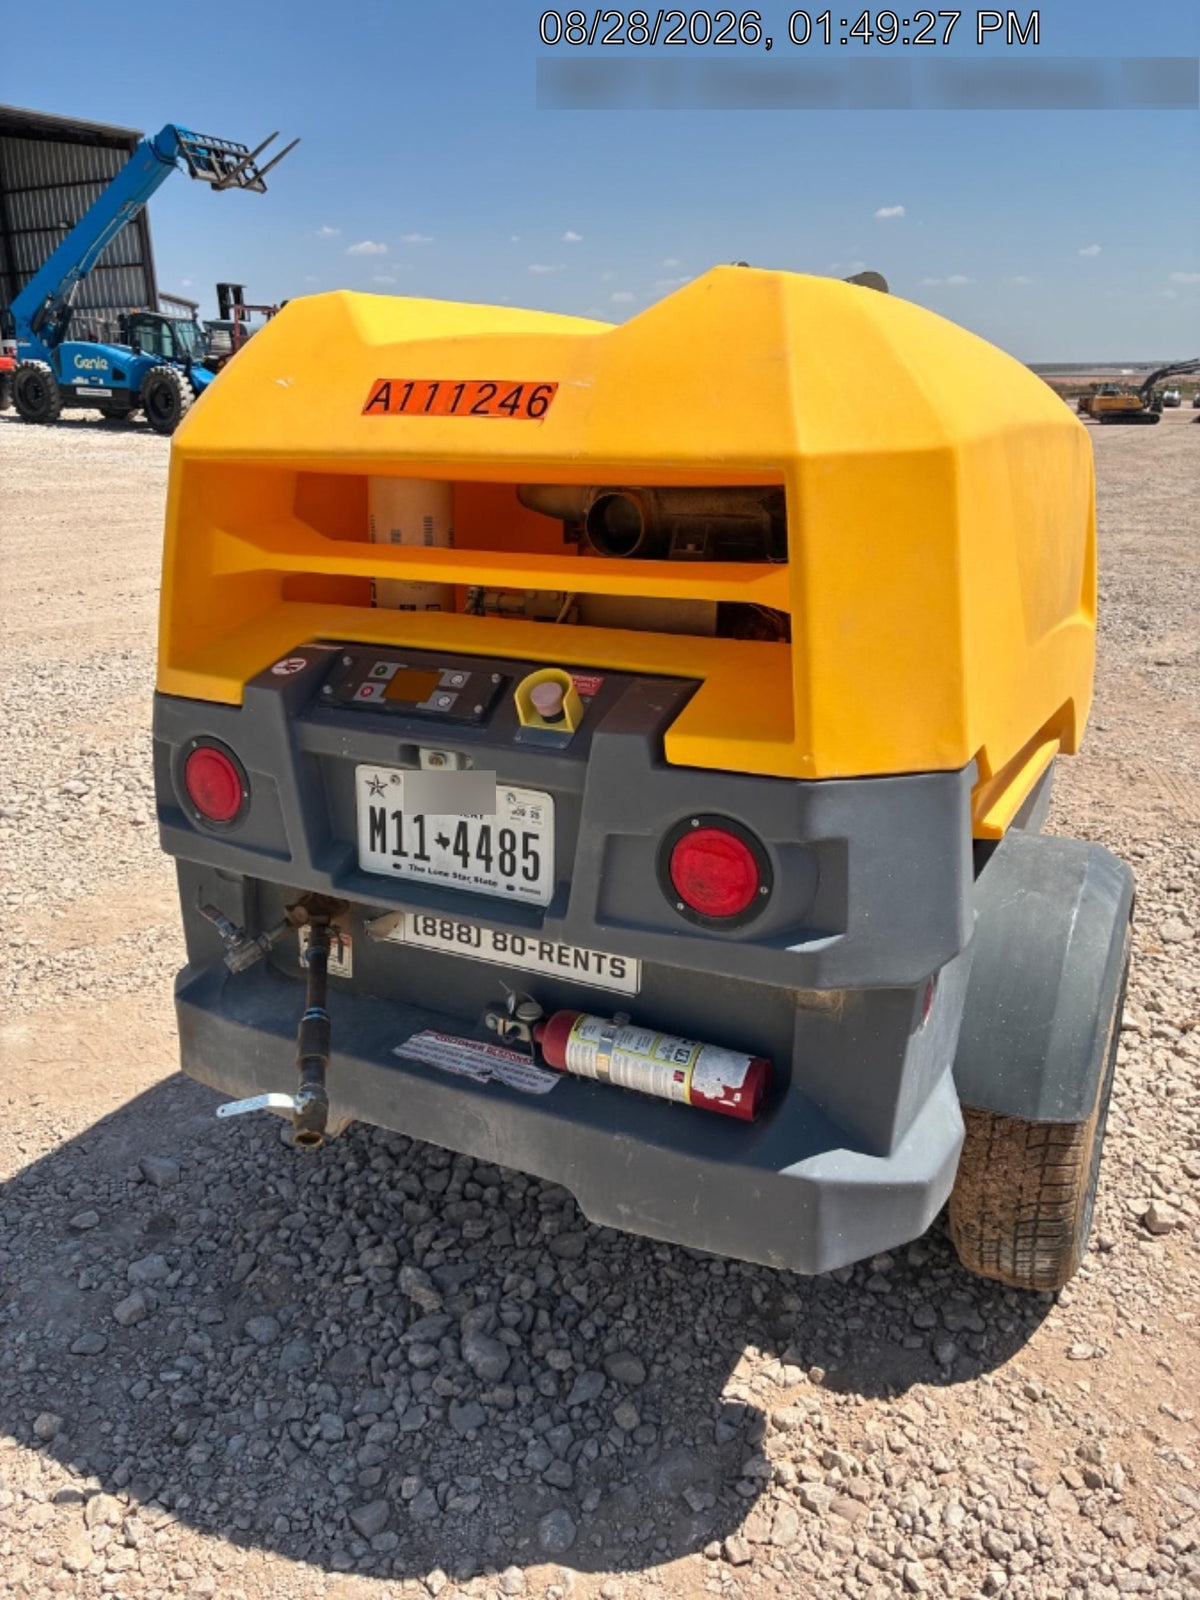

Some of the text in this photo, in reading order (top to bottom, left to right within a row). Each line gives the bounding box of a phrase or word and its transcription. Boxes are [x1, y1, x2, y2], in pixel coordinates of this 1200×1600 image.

[73, 353, 109, 371] Genie
[365, 381, 553, 418] A111246
[452, 820, 540, 882] 4485
[409, 863, 426, 875] The
[473, 875, 499, 888] State
[413, 914, 627, 979] (888) 80-RENTS
